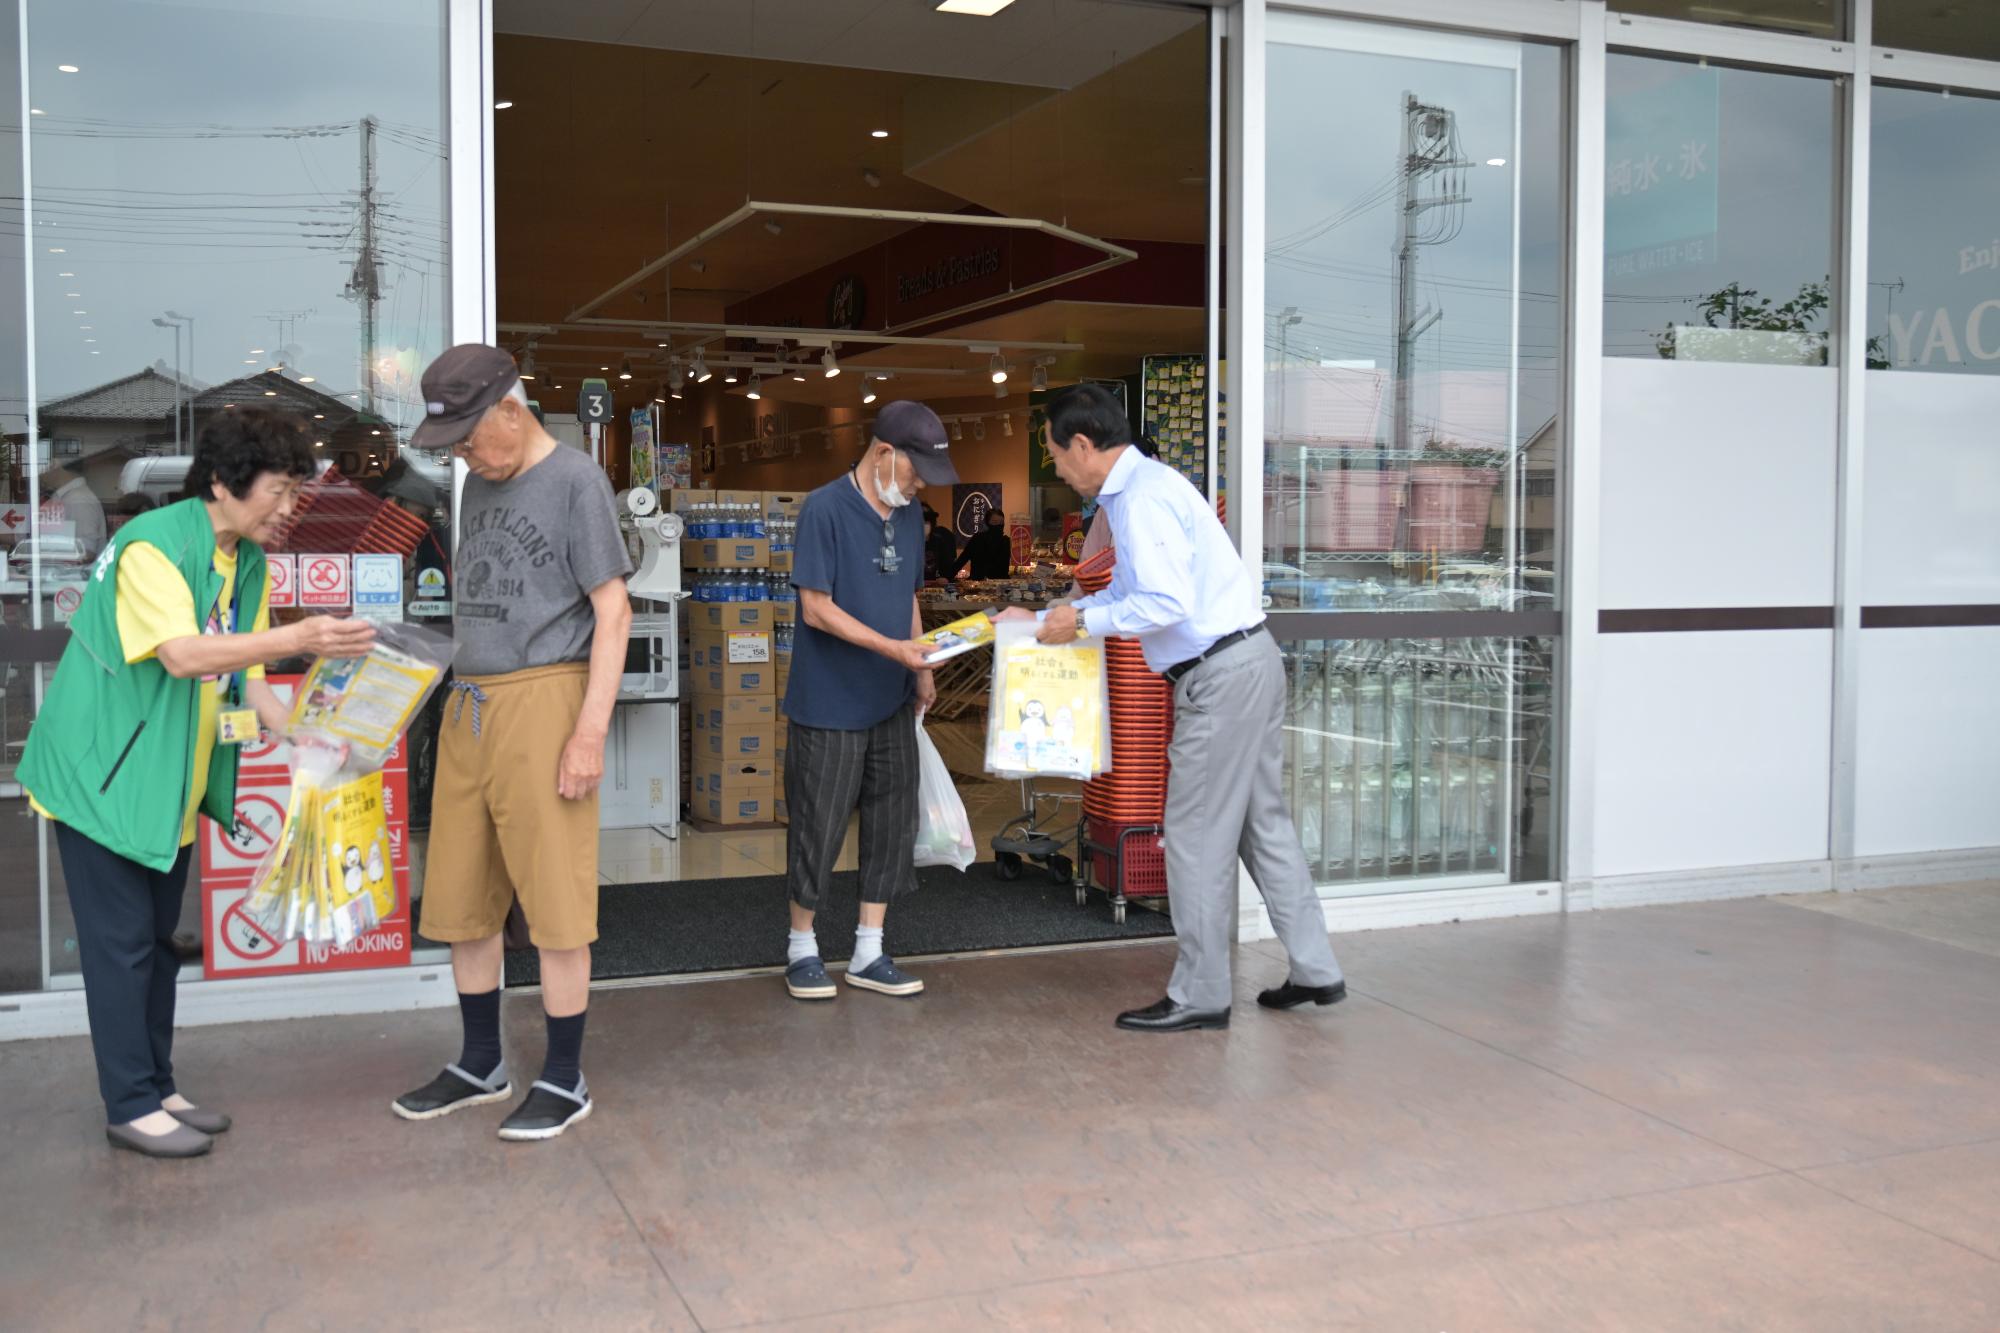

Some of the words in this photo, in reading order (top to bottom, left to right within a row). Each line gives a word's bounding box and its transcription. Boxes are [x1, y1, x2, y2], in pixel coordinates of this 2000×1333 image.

[897, 265, 933, 303] Breads
[936, 259, 946, 290] &
[948, 247, 1000, 286] Pastries
[588, 395, 604, 417] 3
[972, 497, 981, 534] おにぎり
[490, 507, 554, 568] FALCONS
[497, 578, 524, 597] 1914
